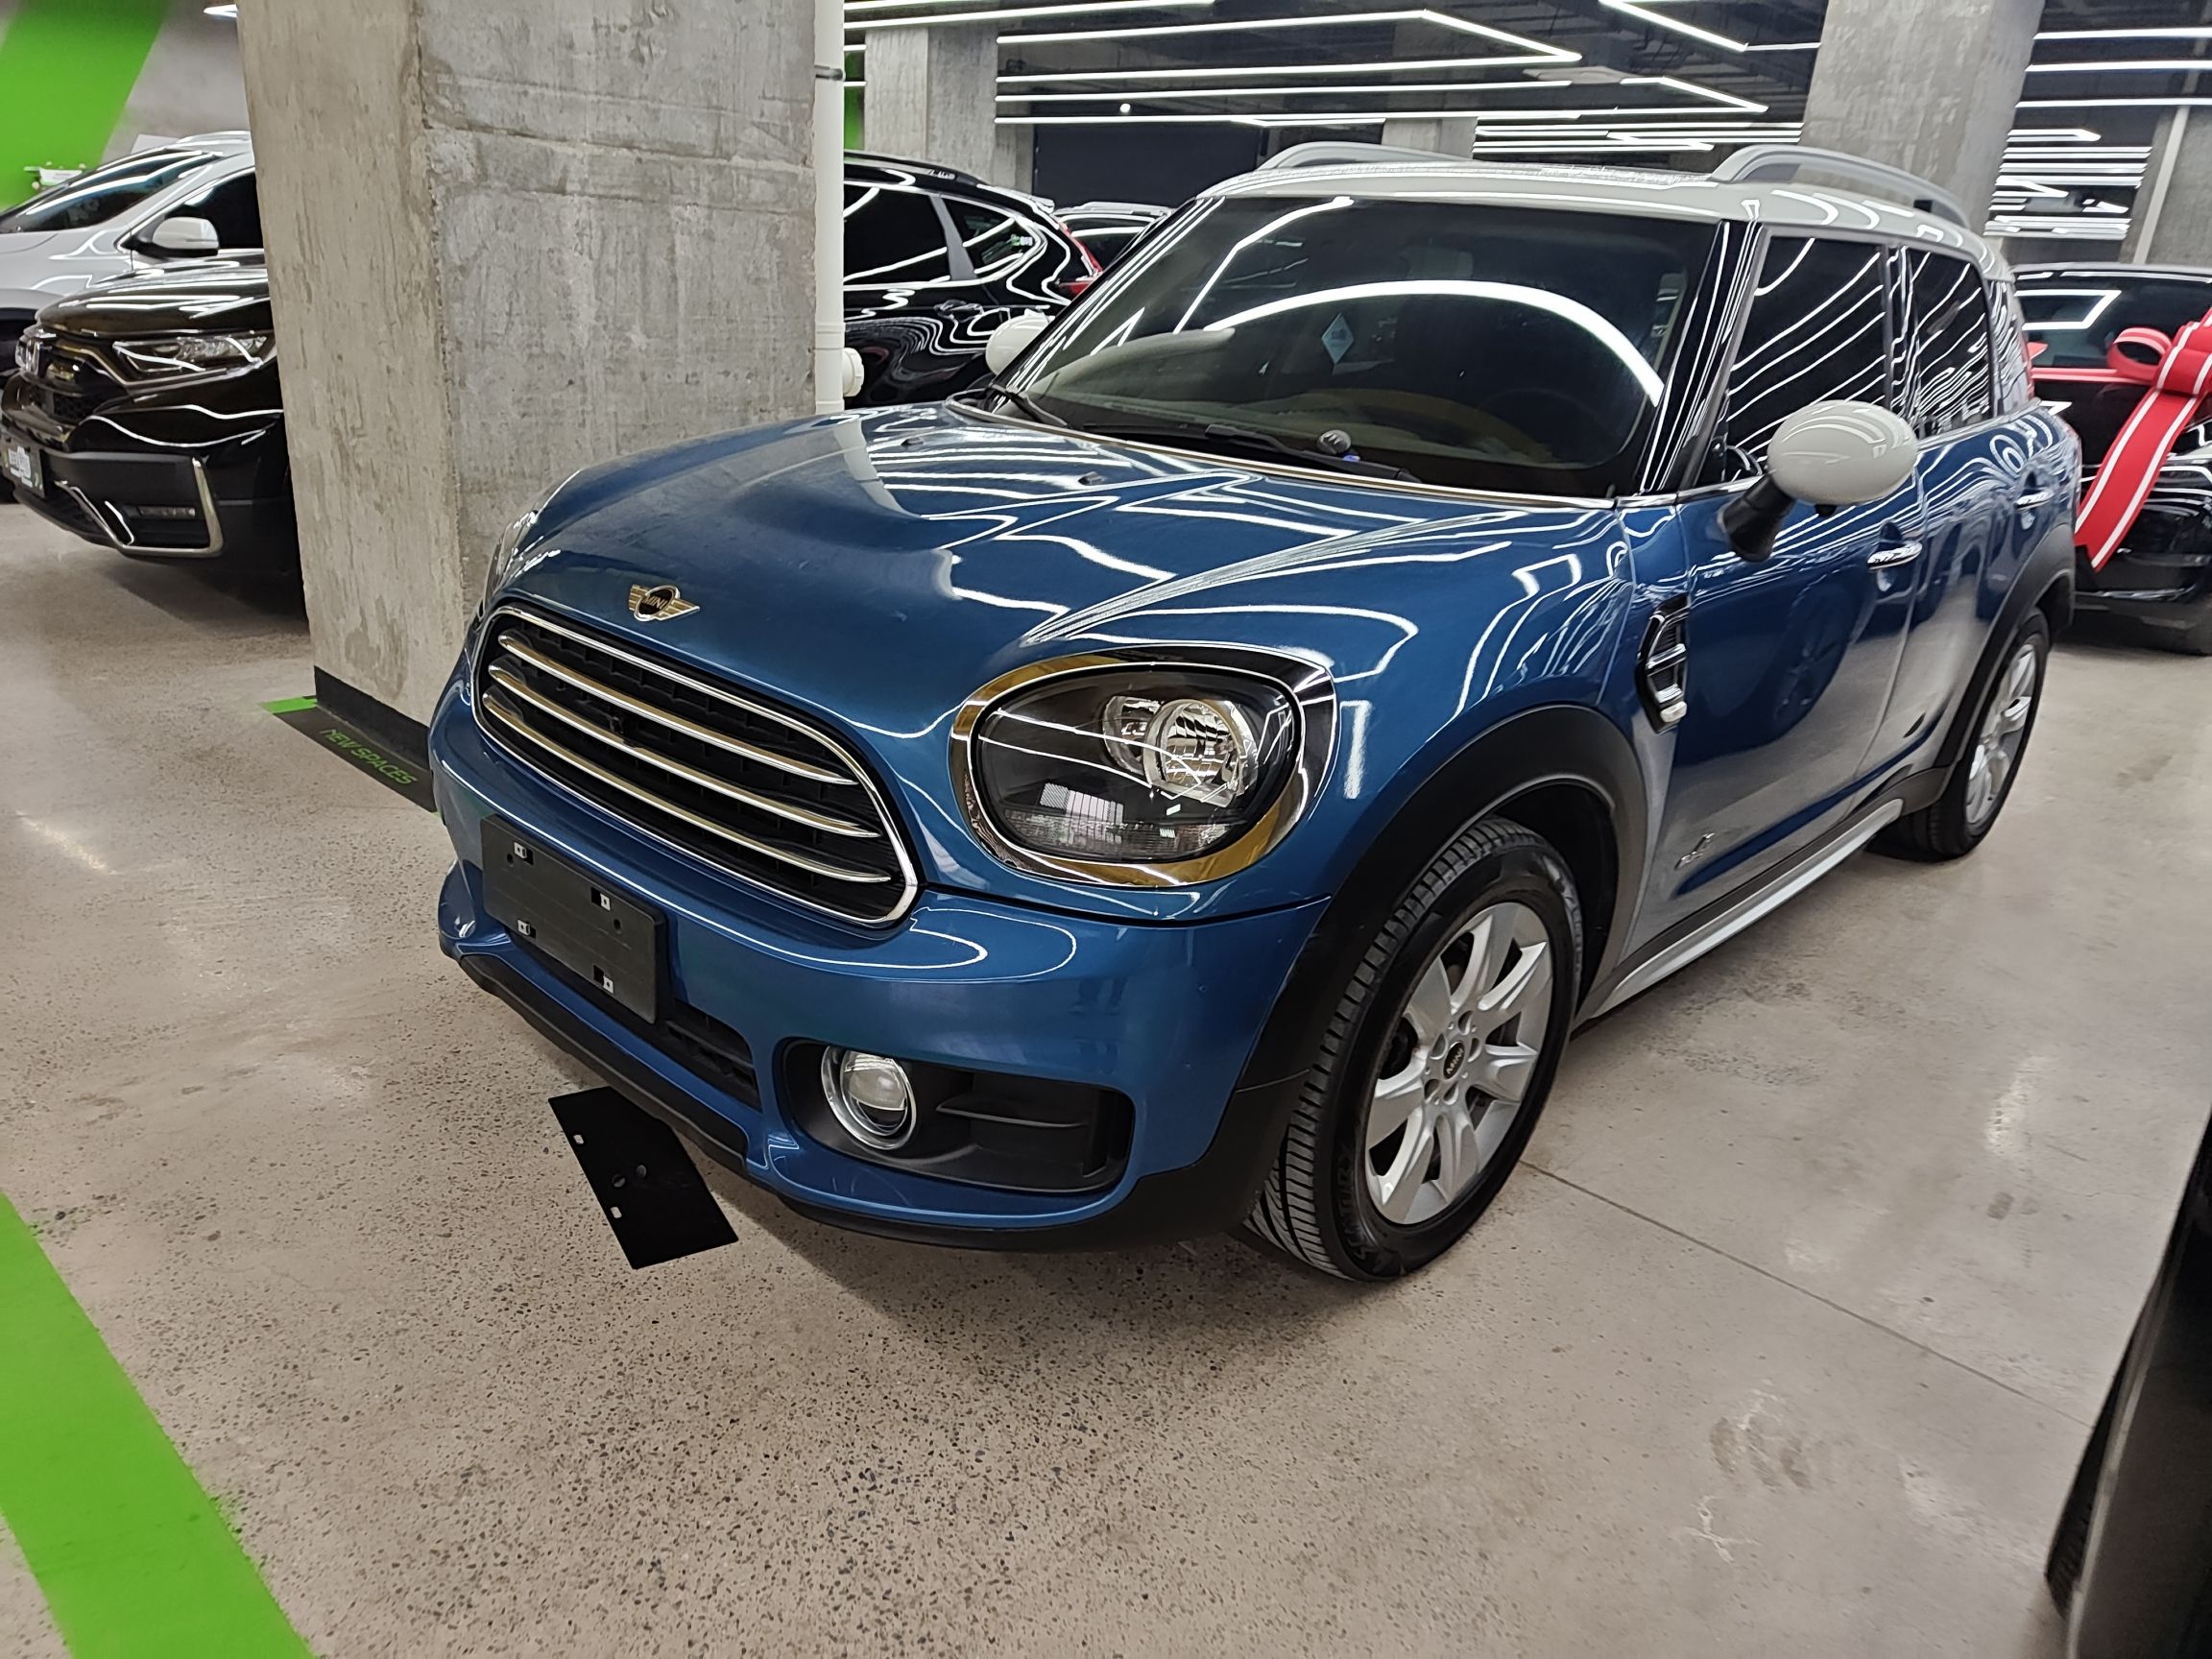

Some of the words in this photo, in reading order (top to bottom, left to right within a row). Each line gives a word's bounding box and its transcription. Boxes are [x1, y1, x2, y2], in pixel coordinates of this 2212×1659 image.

[642, 595, 668, 610] MINI
[320, 729, 357, 753] NEW
[351, 748, 418, 784] SPACES
[1446, 1047, 1464, 1074] MINI
